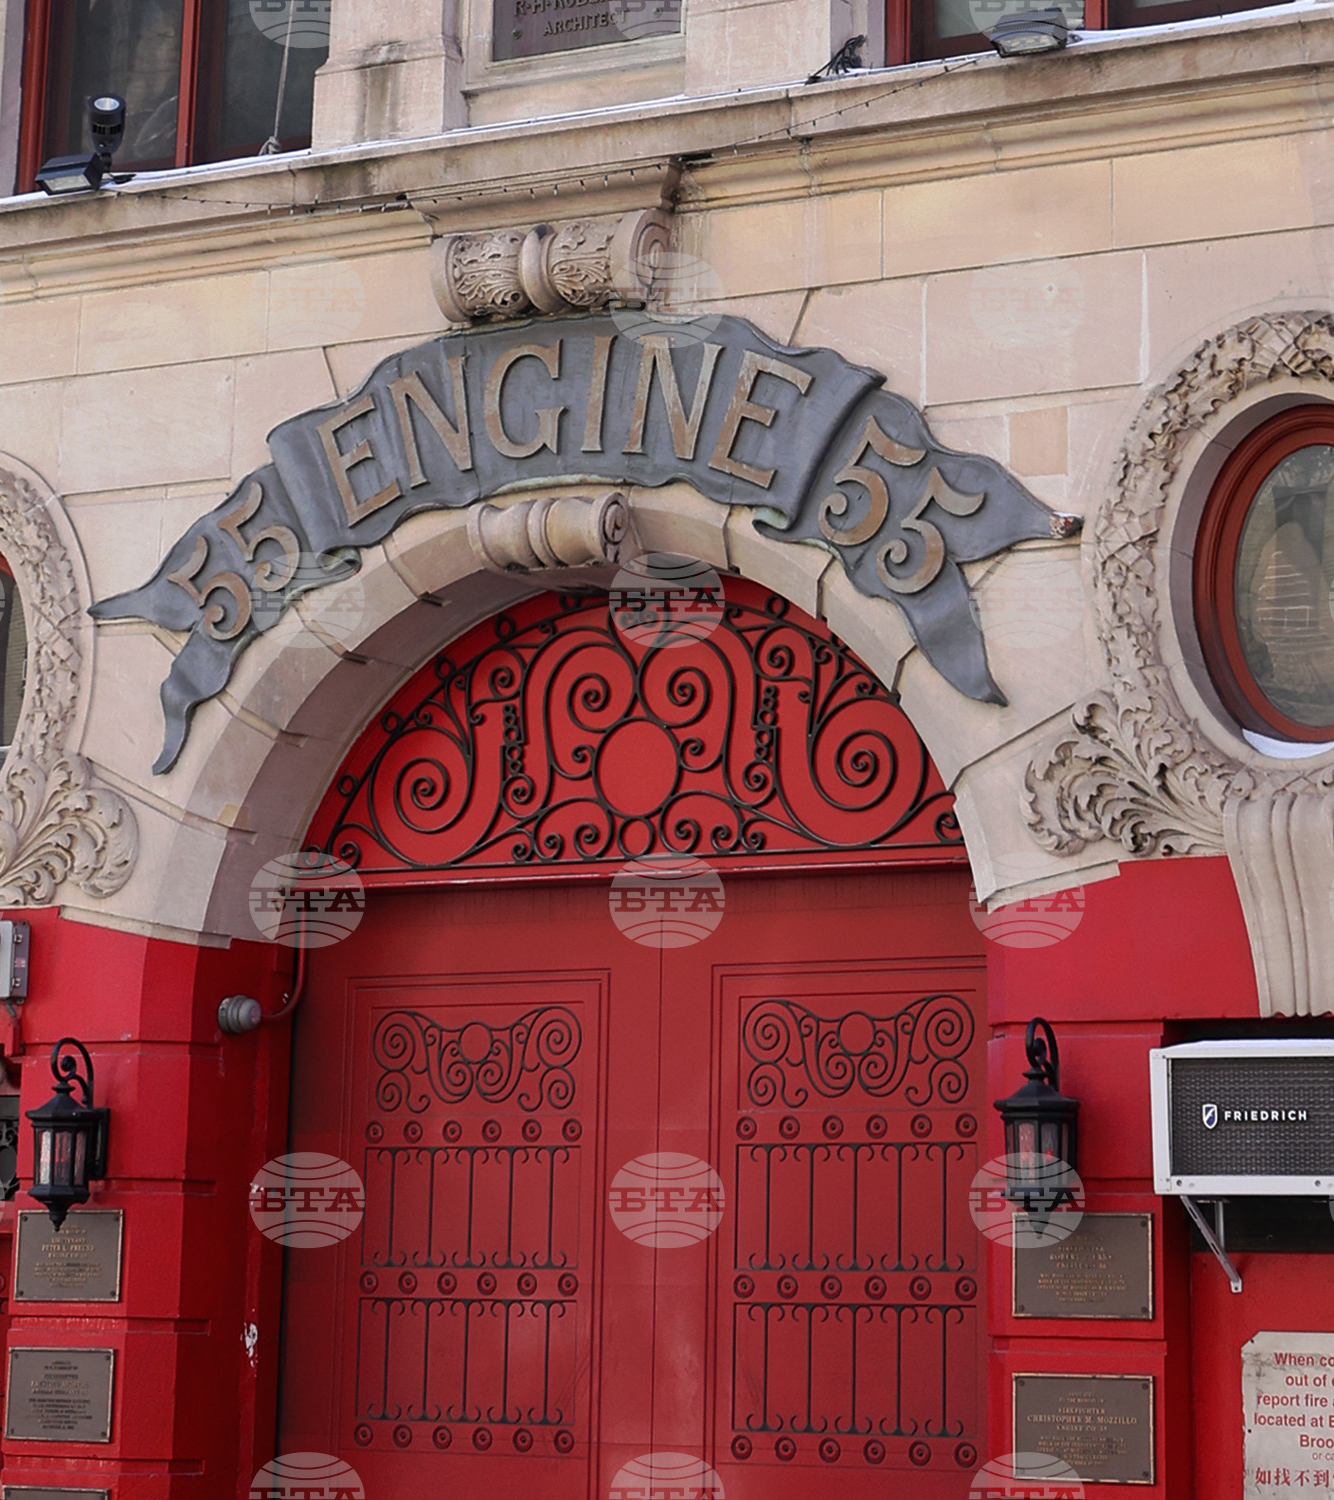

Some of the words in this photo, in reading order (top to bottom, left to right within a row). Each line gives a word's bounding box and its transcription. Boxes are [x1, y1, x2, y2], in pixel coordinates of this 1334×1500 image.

[542, 7, 631, 37] ARCHITECT
[165, 480, 303, 644] 55
[314, 332, 815, 529] ENGINE
[817, 413, 990, 597] 55
[1224, 1110, 1308, 1122] FRIEDRICH
[1274, 1351, 1315, 1367] When
[1285, 1374, 1309, 1387] out
[1312, 1374, 1328, 1388] of
[1256, 1394, 1301, 1411] report
[1304, 1394, 1328, 1408] fire
[1253, 1412, 1306, 1427] located
[1310, 1415, 1324, 1428] at
[1311, 1453, 1323, 1461] or
